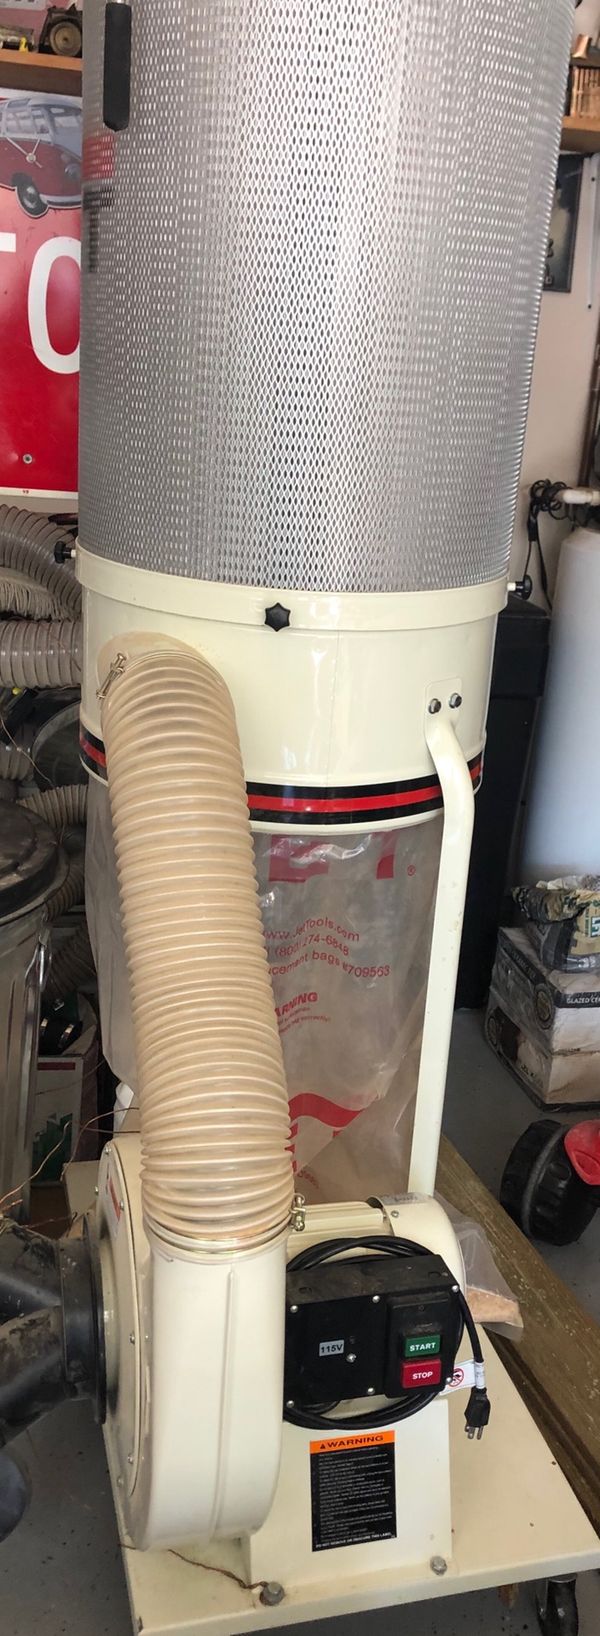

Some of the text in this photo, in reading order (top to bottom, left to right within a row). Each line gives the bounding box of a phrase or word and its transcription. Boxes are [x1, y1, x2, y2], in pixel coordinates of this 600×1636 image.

[263, 916, 360, 942] ww.JetTools.com
[268, 953, 308, 976] cement
[321, 1344, 344, 1354] 115V
[409, 1342, 436, 1352] START
[412, 1371, 433, 1380] STOP
[327, 1434, 384, 1448] WARNING
